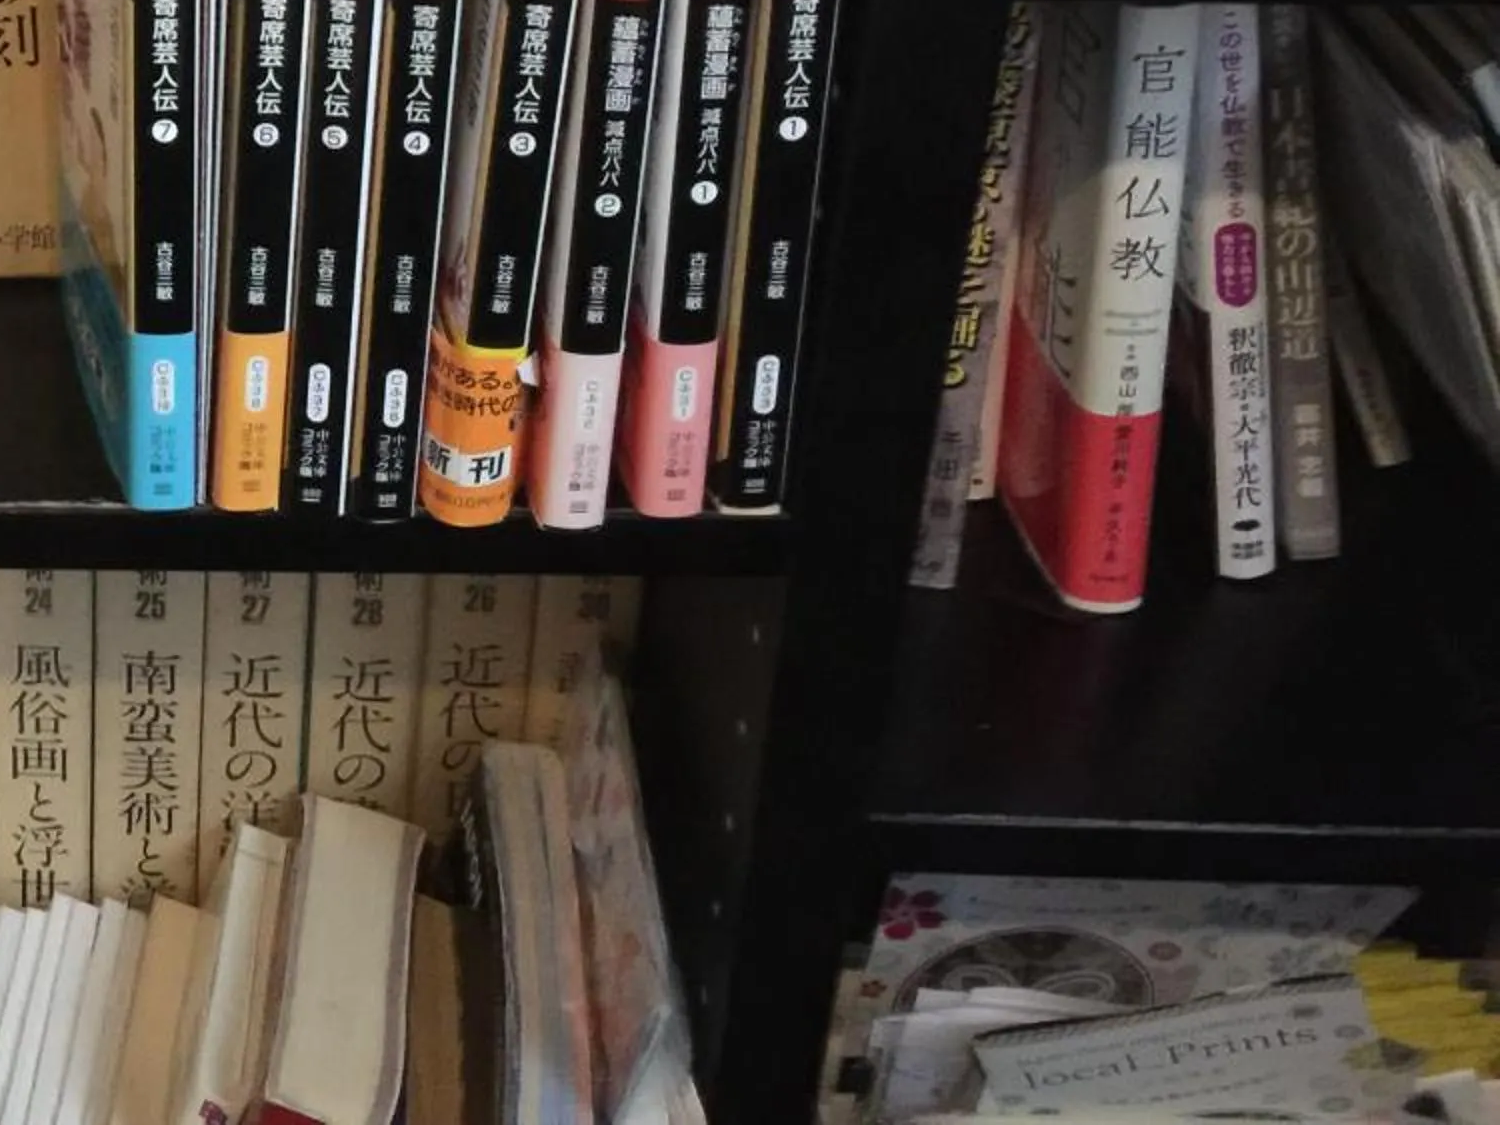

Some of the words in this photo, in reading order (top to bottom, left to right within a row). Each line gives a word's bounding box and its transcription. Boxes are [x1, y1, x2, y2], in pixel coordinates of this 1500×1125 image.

[405, 5, 440, 124] 寄席芸人伝
[513, 5, 553, 124] 寄席芸人伝
[1111, 46, 1186, 281] 官能仏教
[25, 586, 53, 616] 24
[134, 589, 166, 622] 25
[241, 590, 272, 624] 27
[351, 595, 384, 627] 28
[464, 586, 497, 614] 26
